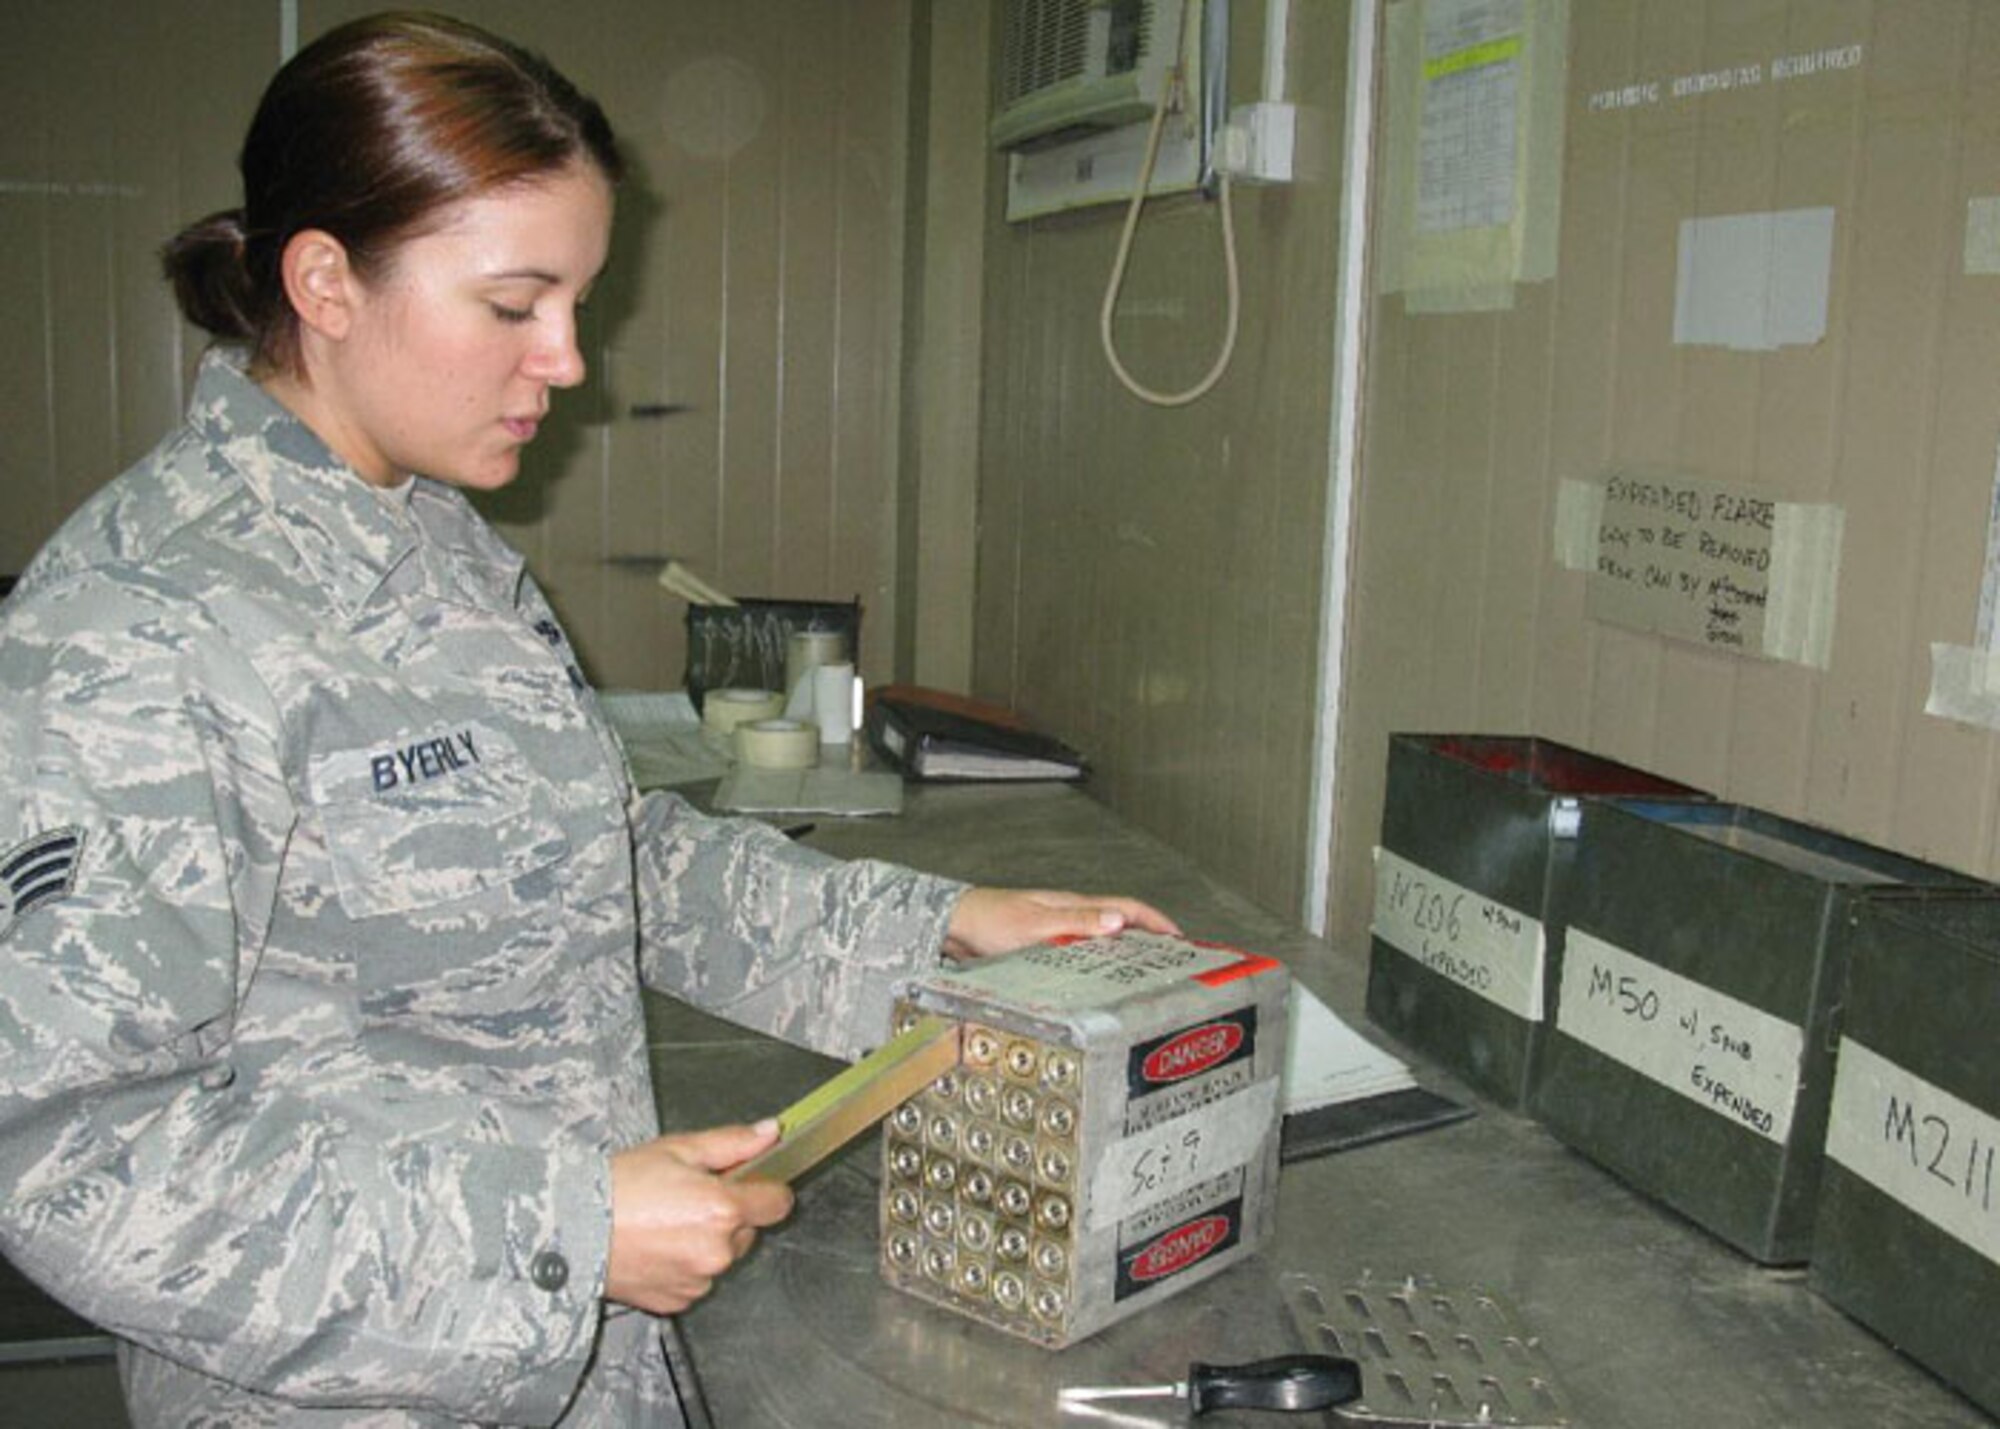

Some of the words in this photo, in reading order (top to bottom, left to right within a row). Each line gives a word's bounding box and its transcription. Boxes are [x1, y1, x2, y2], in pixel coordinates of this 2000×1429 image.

[1711, 494, 1774, 529] FLARE
[1662, 527, 1687, 548] BE
[1700, 531, 1771, 572] REMOVED
[371, 730, 480, 792] BYERLY
[1588, 964, 1659, 1020] M50
[1159, 1029, 1228, 1075] DANGER
[1691, 1065, 1773, 1132] EXPENDED
[1885, 1096, 1994, 1211] M211
[1149, 1222, 1216, 1273] DANGER
